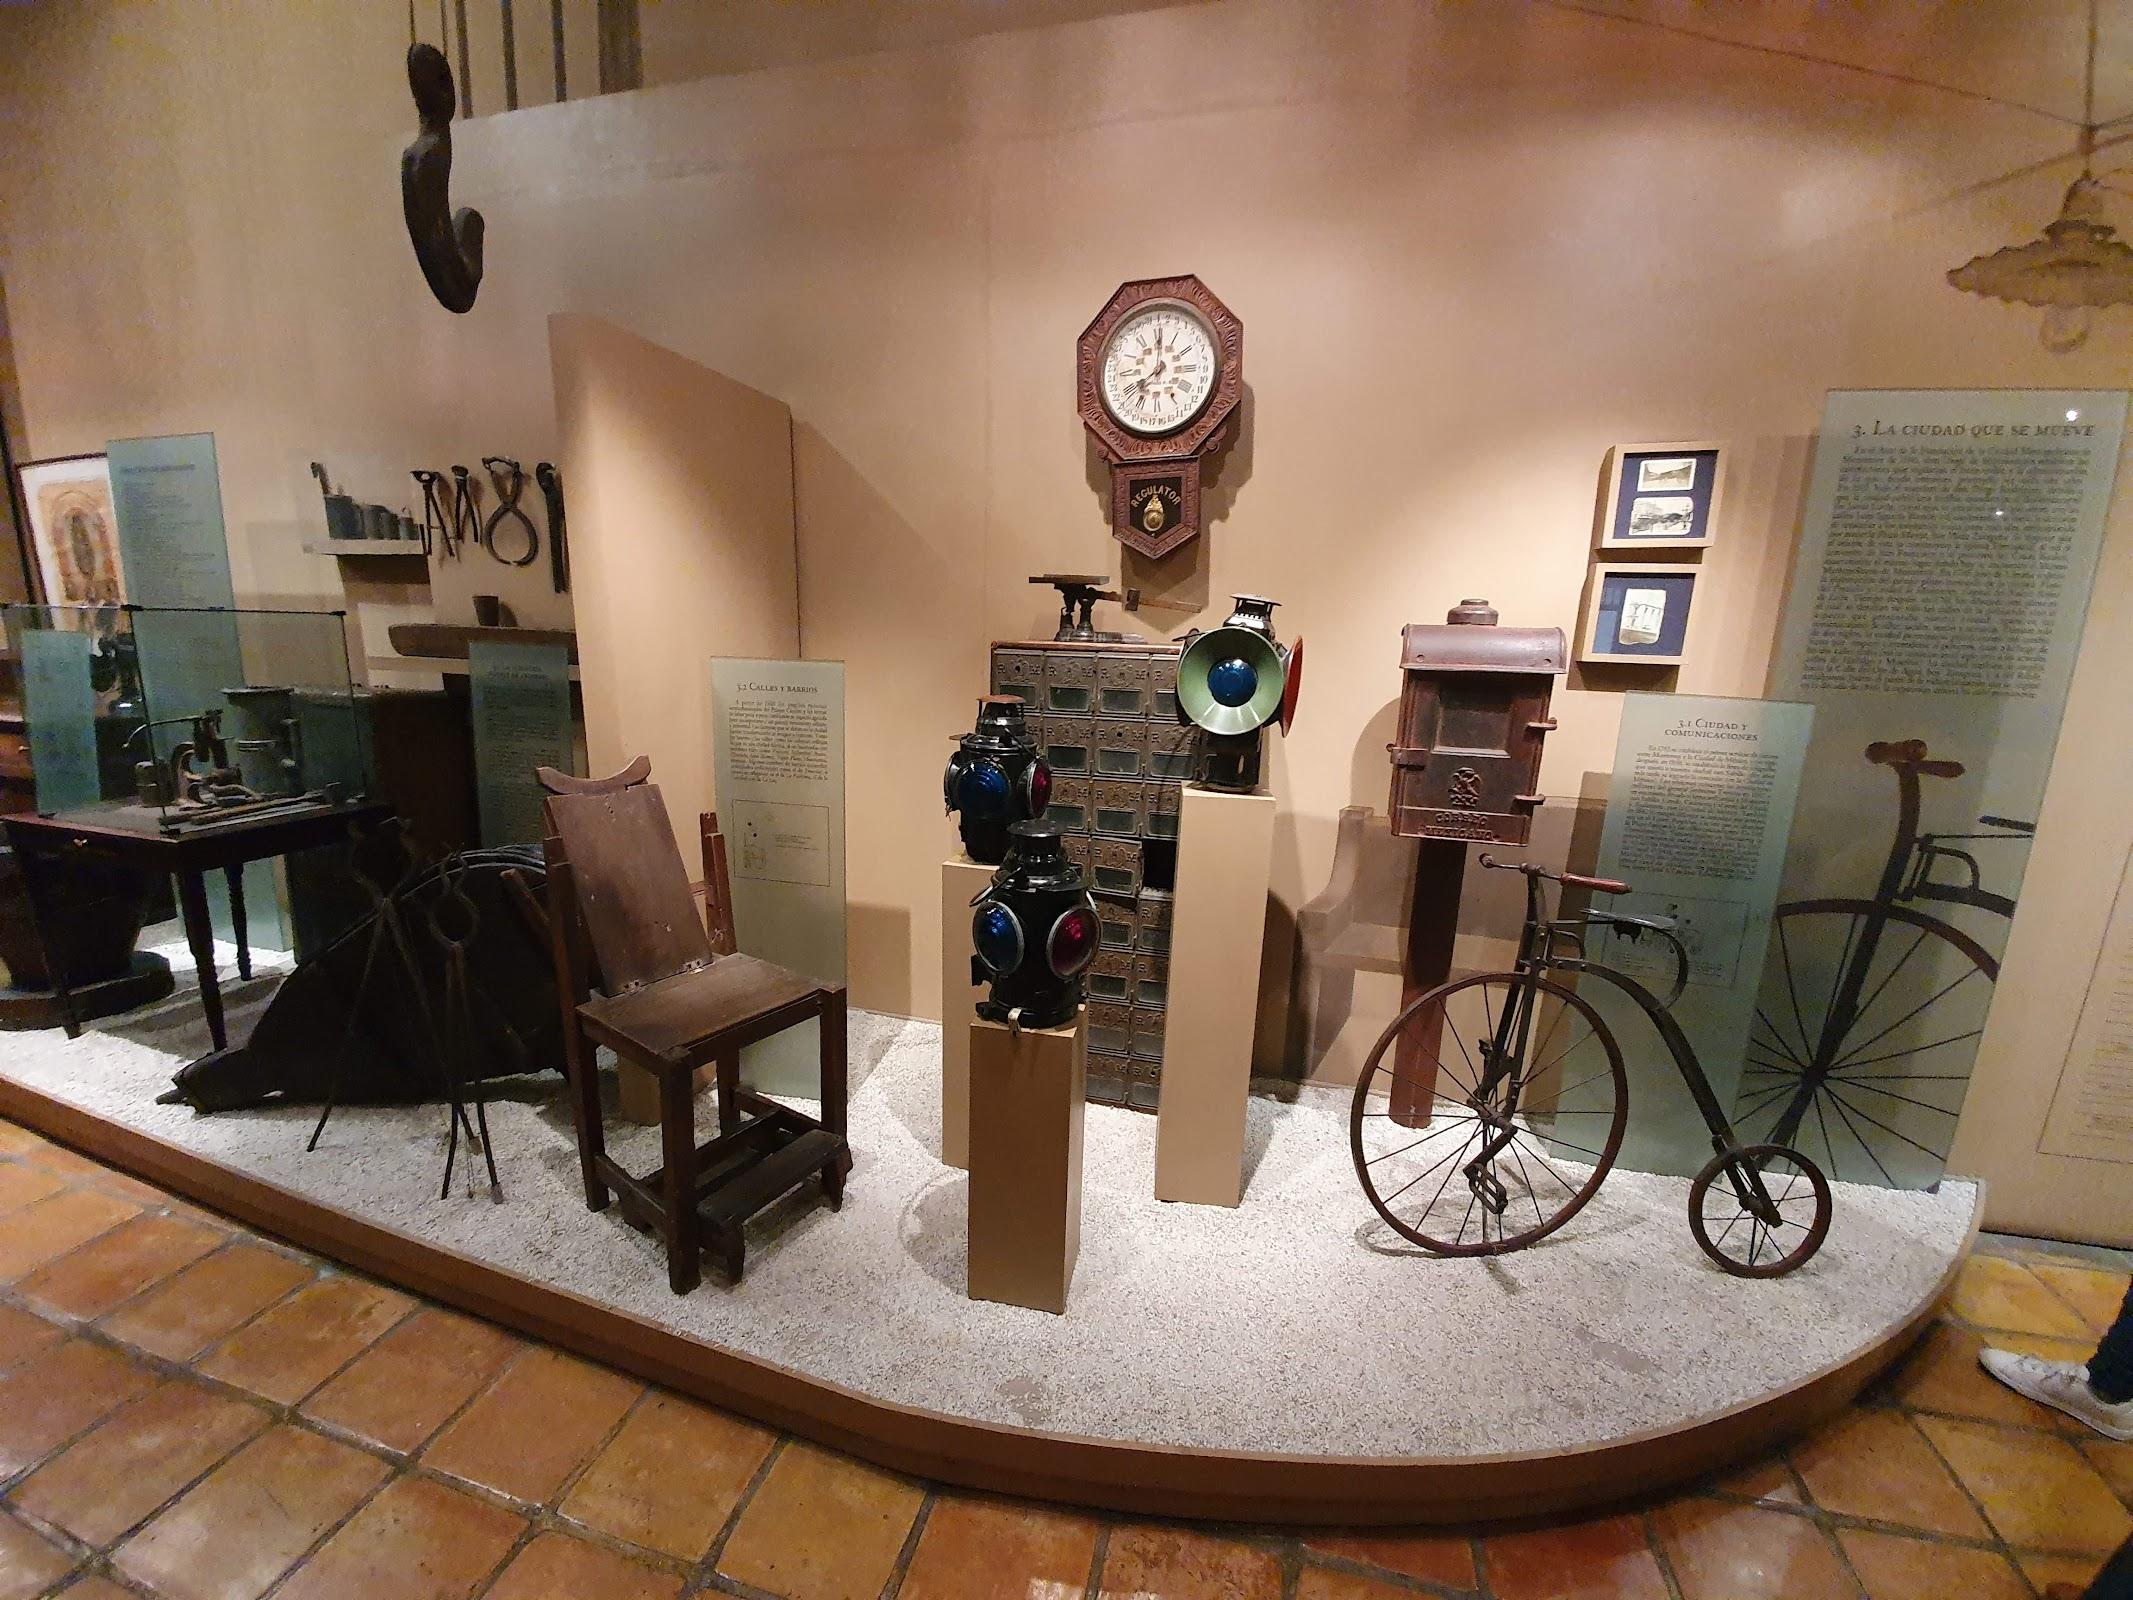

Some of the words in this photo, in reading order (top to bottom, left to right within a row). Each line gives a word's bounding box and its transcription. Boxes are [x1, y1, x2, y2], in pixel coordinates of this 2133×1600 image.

[1903, 424, 1966, 437] CIUDAD
[1971, 425, 2004, 438] QUE
[2011, 424, 2031, 436] SE
[2034, 424, 2095, 437] MUEVE
[1131, 485, 1181, 508] REGULATOR
[749, 682, 778, 692] CALLES
[787, 685, 818, 693] BARRIOS
[1695, 718, 1739, 730] CIUDAD
[1664, 728, 1758, 741] COMUNICACIONES
